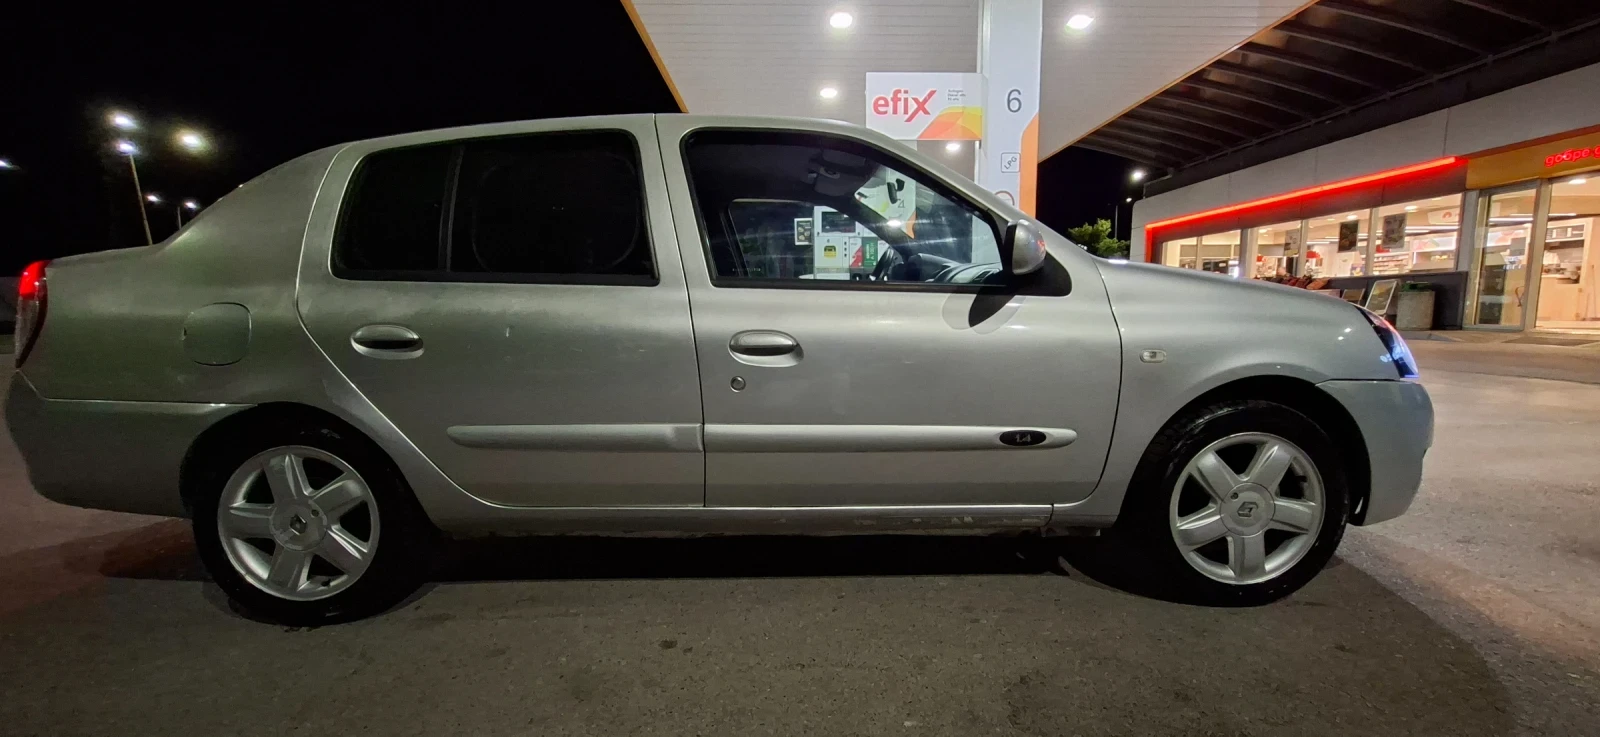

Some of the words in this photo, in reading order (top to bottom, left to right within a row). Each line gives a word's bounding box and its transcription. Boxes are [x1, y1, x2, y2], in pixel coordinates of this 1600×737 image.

[872, 89, 937, 122] efix
[1006, 88, 1022, 113] 6
[1003, 156, 1018, 170] LPG
